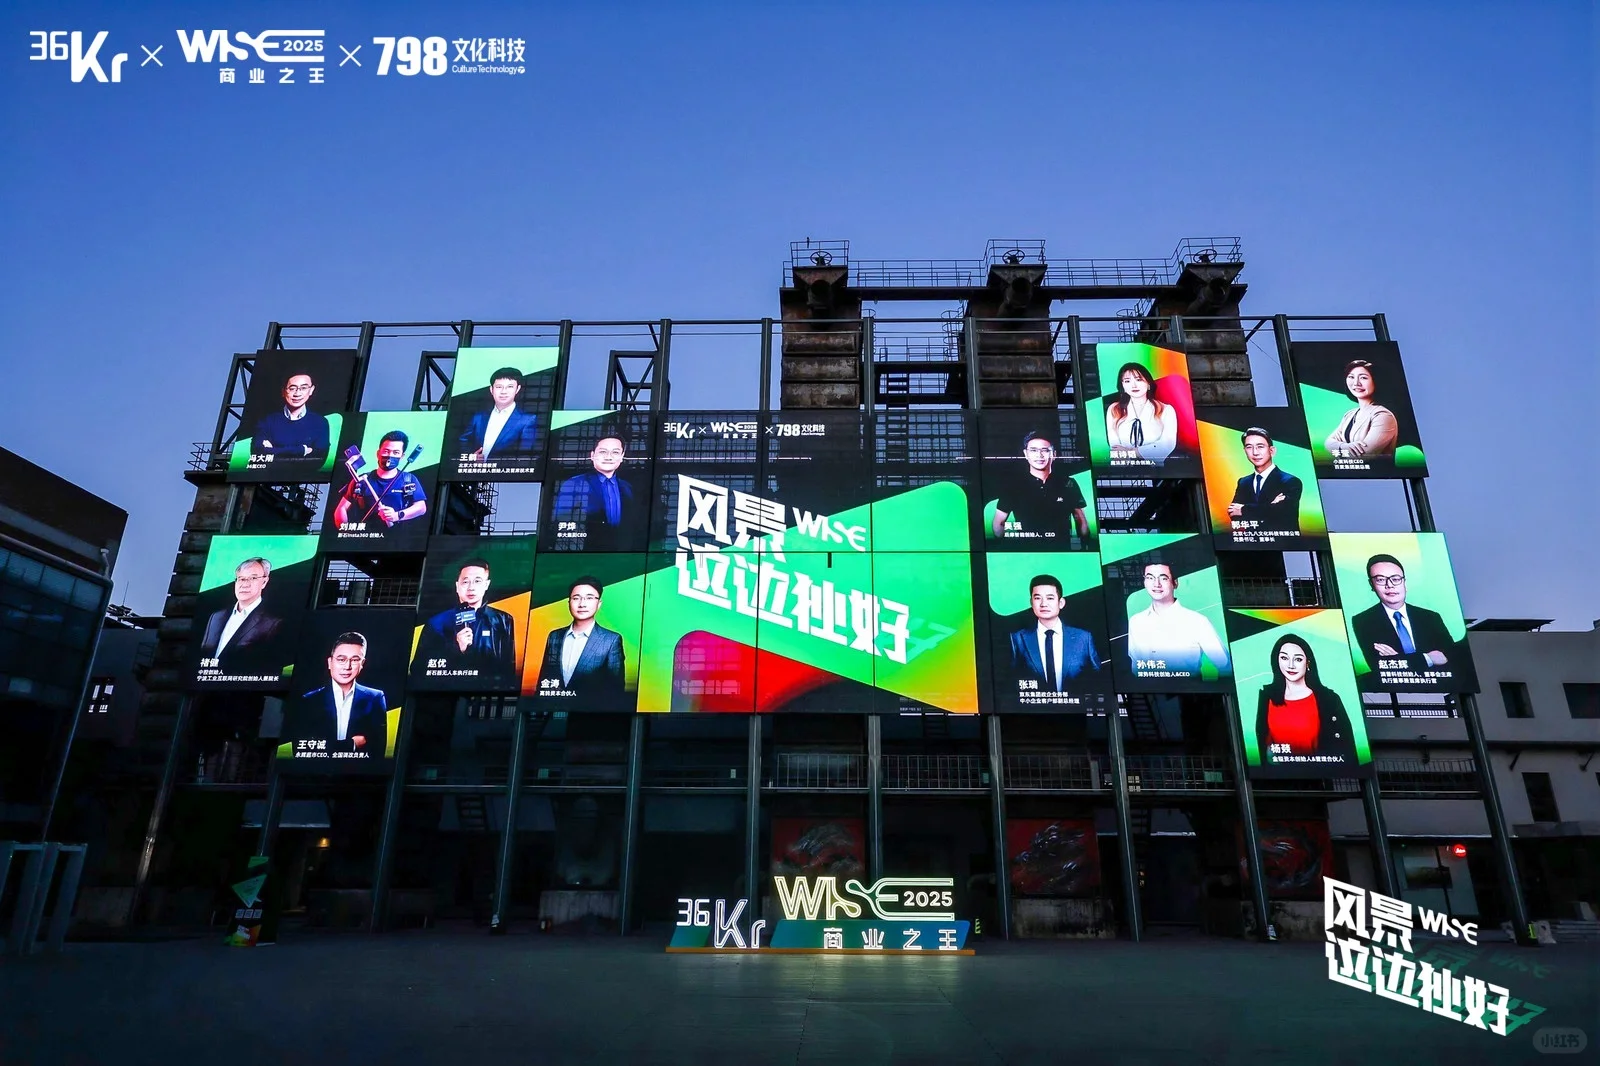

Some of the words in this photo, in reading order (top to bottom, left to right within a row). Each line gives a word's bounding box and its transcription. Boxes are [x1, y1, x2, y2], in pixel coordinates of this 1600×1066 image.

[776, 424, 801, 437] 798
[801, 424, 825, 432] 文化科技
[247, 454, 275, 463] 冯大刚
[676, 474, 787, 562] 风景
[1136, 660, 1167, 669] 孙伟杰
[297, 740, 327, 750] 王守诚
[903, 890, 953, 907] 2025
[823, 927, 958, 951] 商业之王
